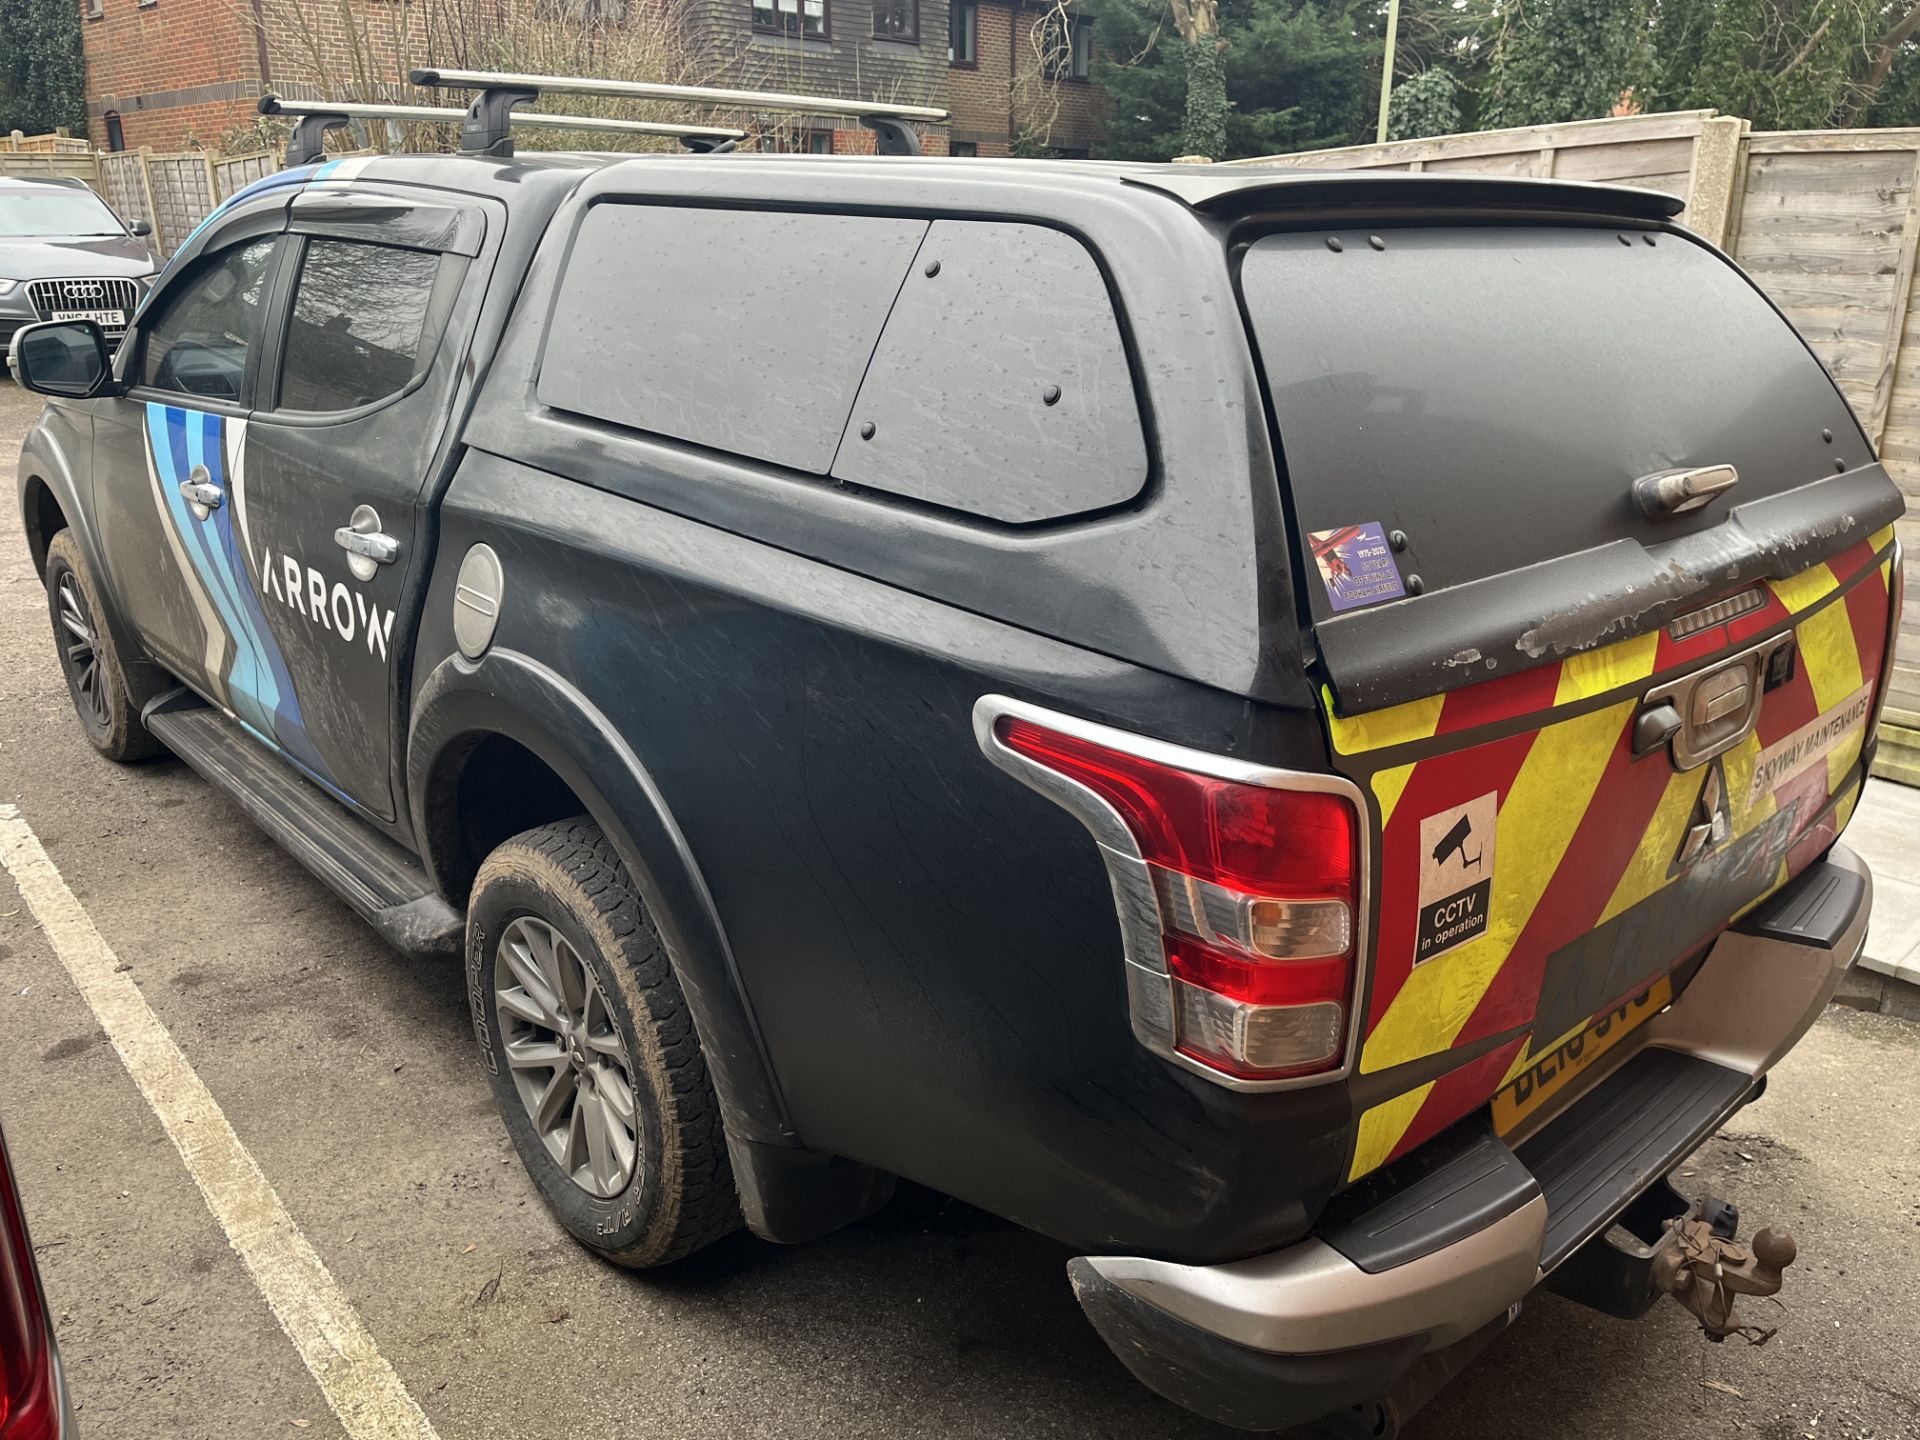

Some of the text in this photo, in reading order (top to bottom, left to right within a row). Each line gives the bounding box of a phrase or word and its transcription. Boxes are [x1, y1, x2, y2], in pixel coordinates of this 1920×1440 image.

[95, 312, 119, 323] HTE
[1357, 546, 1386, 558] 1975-2025
[262, 546, 396, 663] ARROW
[1754, 696, 1868, 789] SKYWAY MAINTENANCE
[1434, 893, 1477, 928] CCTV
[1421, 913, 1483, 951] in operation
[471, 922, 499, 1076] COOPER
